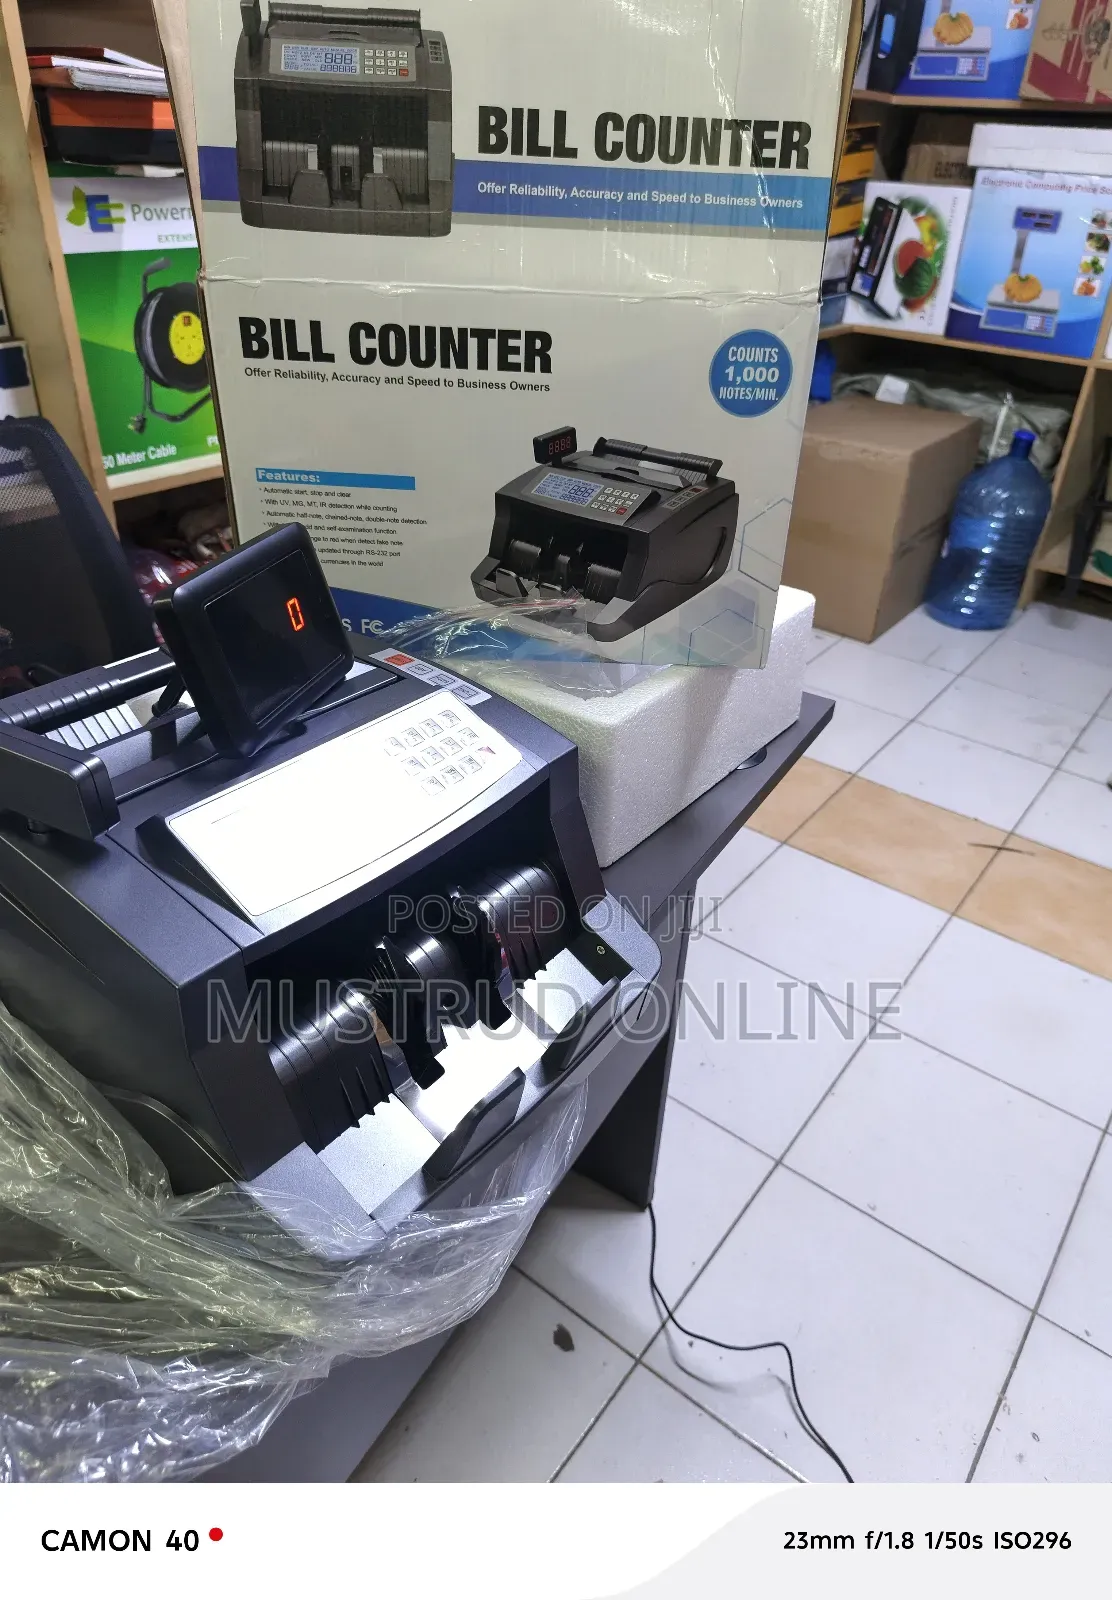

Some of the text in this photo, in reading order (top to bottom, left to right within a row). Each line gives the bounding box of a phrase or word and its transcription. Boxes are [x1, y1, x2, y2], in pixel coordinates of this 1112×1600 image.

[477, 105, 812, 169] BILL COUNTER
[477, 181, 803, 208] Offer Reliability, Accuracy and Speed to Business Owners
[238, 316, 553, 374] BILL COUNTER
[728, 346, 779, 363] COUNTS
[244, 367, 551, 392] Offer Reliability, Accuracy and Speed to Business Owners
[725, 365, 780, 385] 1,000
[719, 386, 779, 401] NOTES/MIN.
[116, 450, 146, 466] Meter
[147, 443, 177, 460] Cable
[257, 469, 321, 483] Features:
[263, 487, 293, 495] Automatic
[266, 510, 296, 518] Automatic
[365, 516, 400, 524] double-note
[372, 505, 398, 513] counting
[342, 548, 365, 556] through
[286, 597, 305, 632] 0
